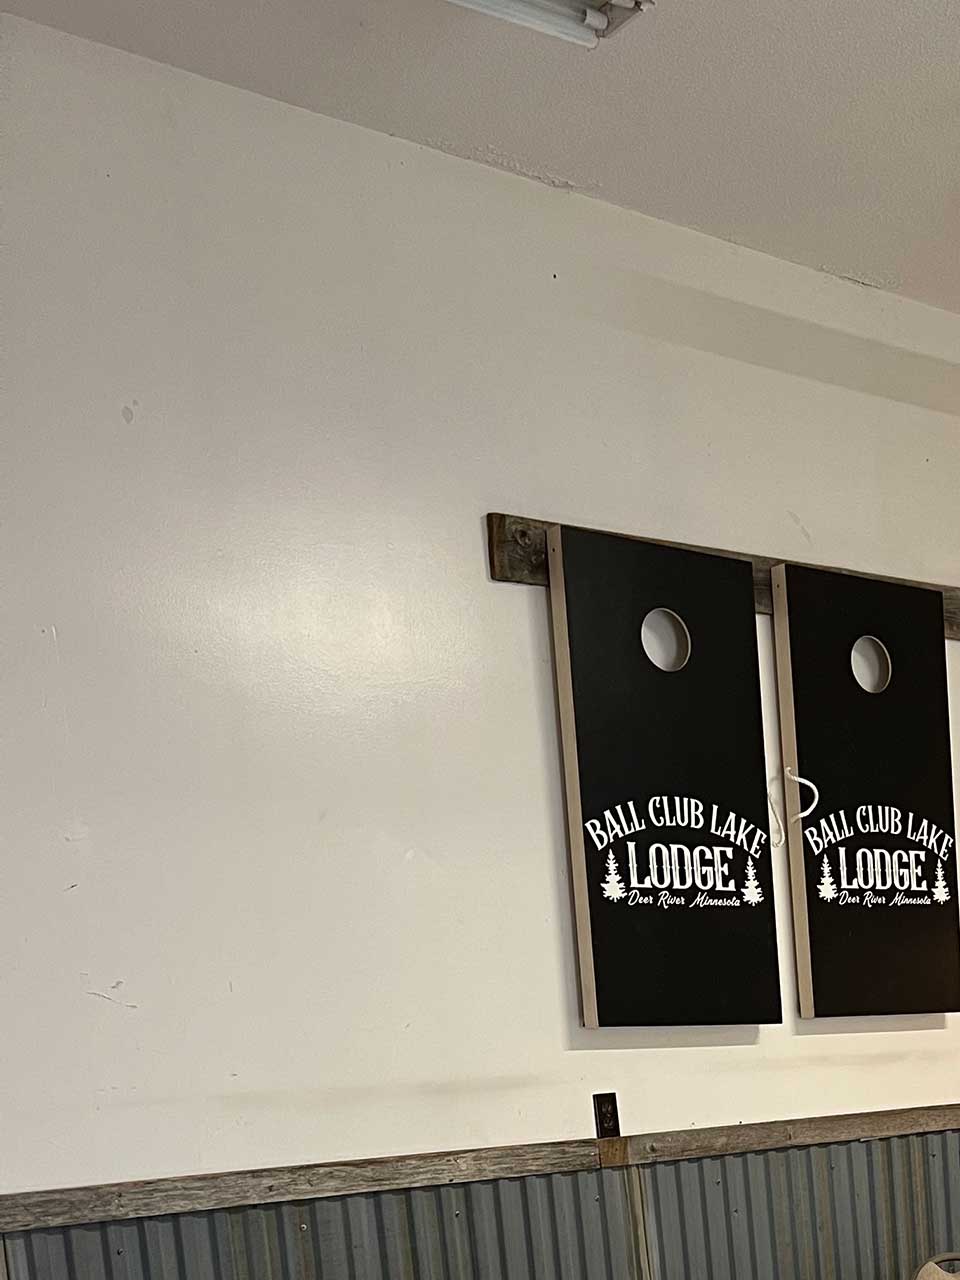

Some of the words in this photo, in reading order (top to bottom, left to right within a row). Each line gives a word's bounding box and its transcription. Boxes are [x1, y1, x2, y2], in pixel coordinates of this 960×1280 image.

[584, 800, 646, 851] BALL
[648, 795, 705, 829] CLUB
[710, 804, 768, 859] LAKE
[804, 809, 855, 856] BALL
[856, 805, 902, 835] CLUB
[906, 811, 954, 862] LAKE
[626, 841, 737, 892] LODGE
[838, 846, 928, 891] LODGE
[627, 889, 654, 906] Deer
[657, 890, 686, 909] River
[688, 891, 741, 908] Minnesota
[838, 890, 860, 906] Deer
[863, 890, 886, 908] River
[888, 891, 932, 907] Minnesota
